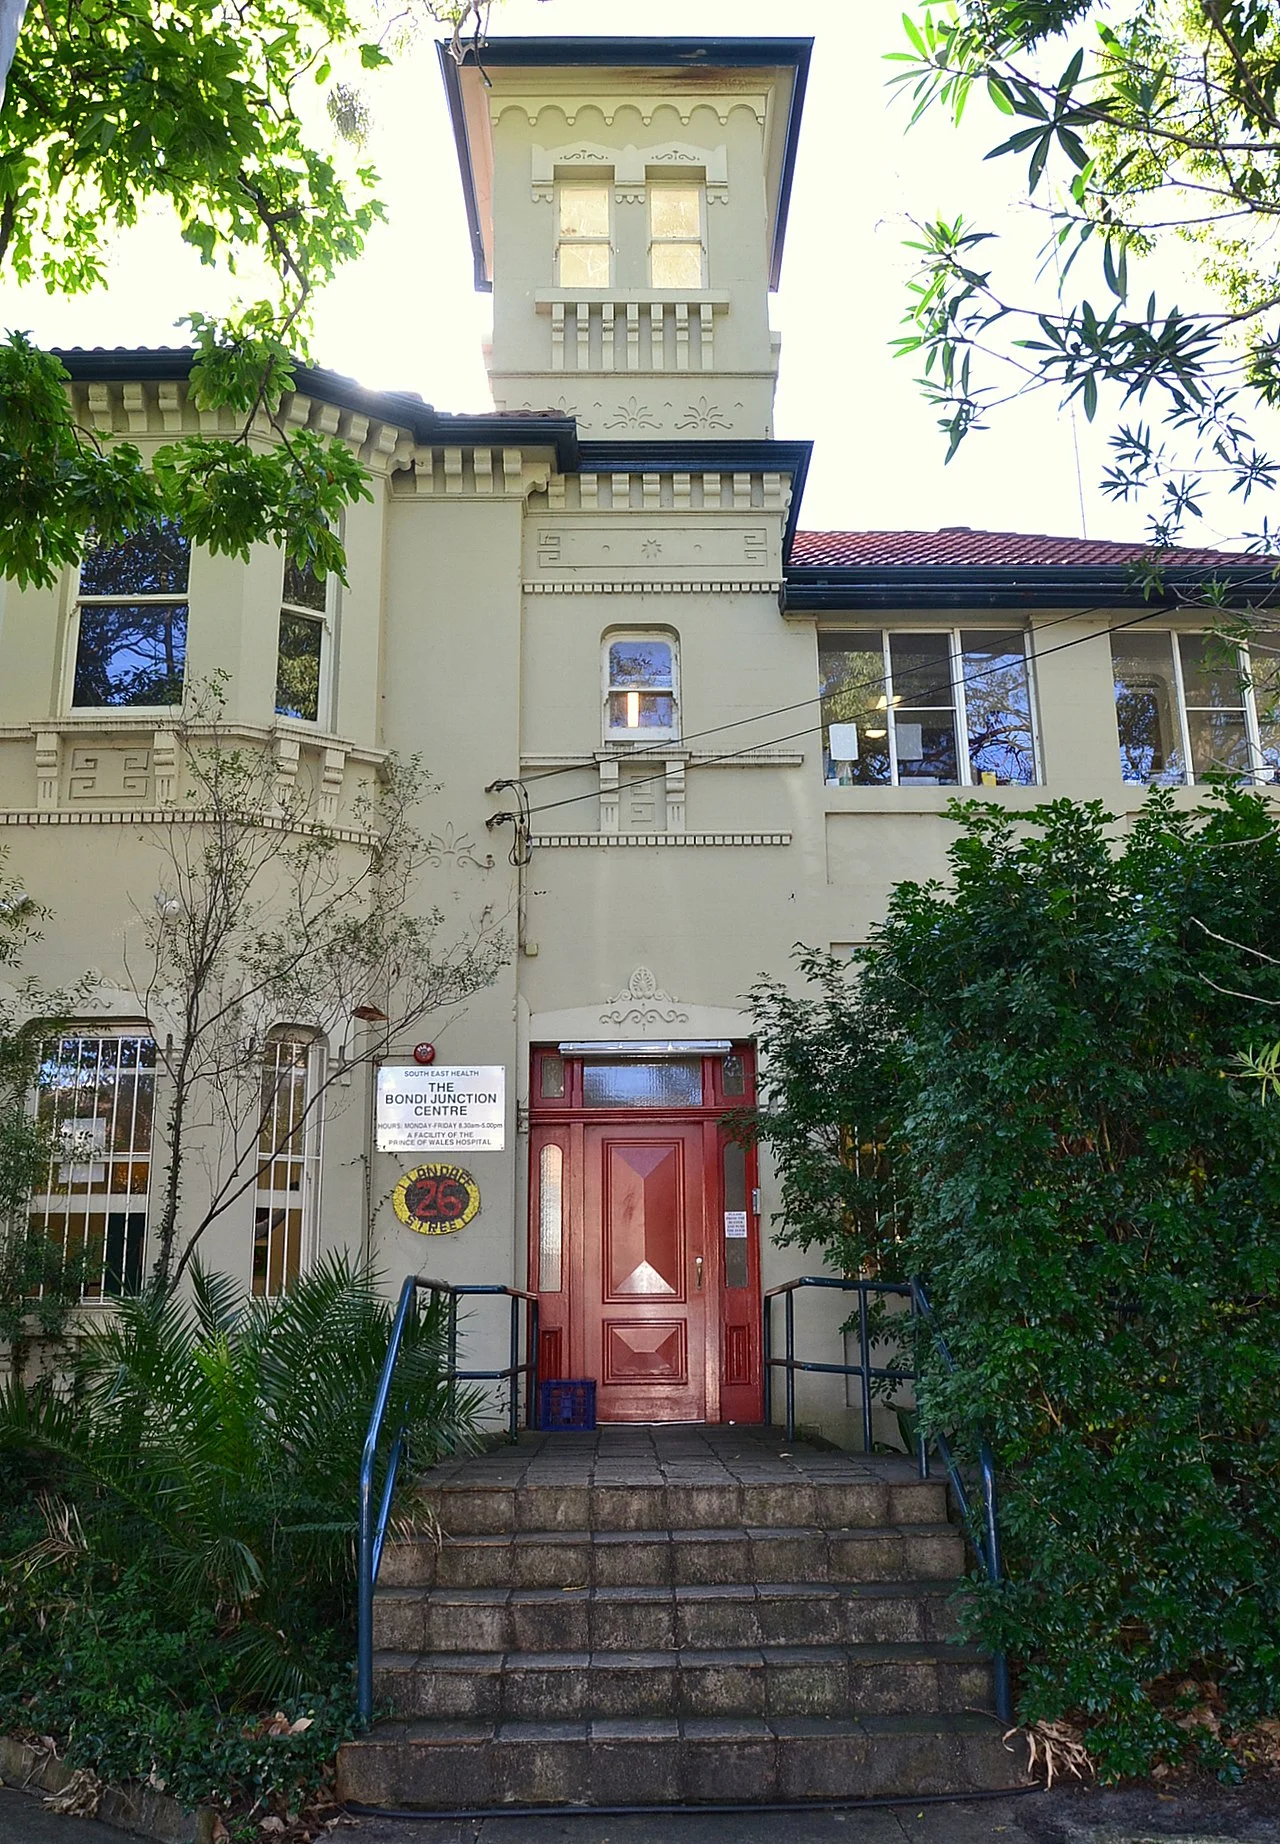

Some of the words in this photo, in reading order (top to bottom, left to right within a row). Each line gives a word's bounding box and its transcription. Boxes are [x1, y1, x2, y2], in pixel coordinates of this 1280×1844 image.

[428, 1082, 454, 1092] THE
[385, 1094, 427, 1104] BONDI
[430, 1093, 497, 1104] JUNCTION
[414, 1105, 468, 1116] CENTRE
[416, 1179, 462, 1216] 26
[405, 1215, 468, 1233] STREET
